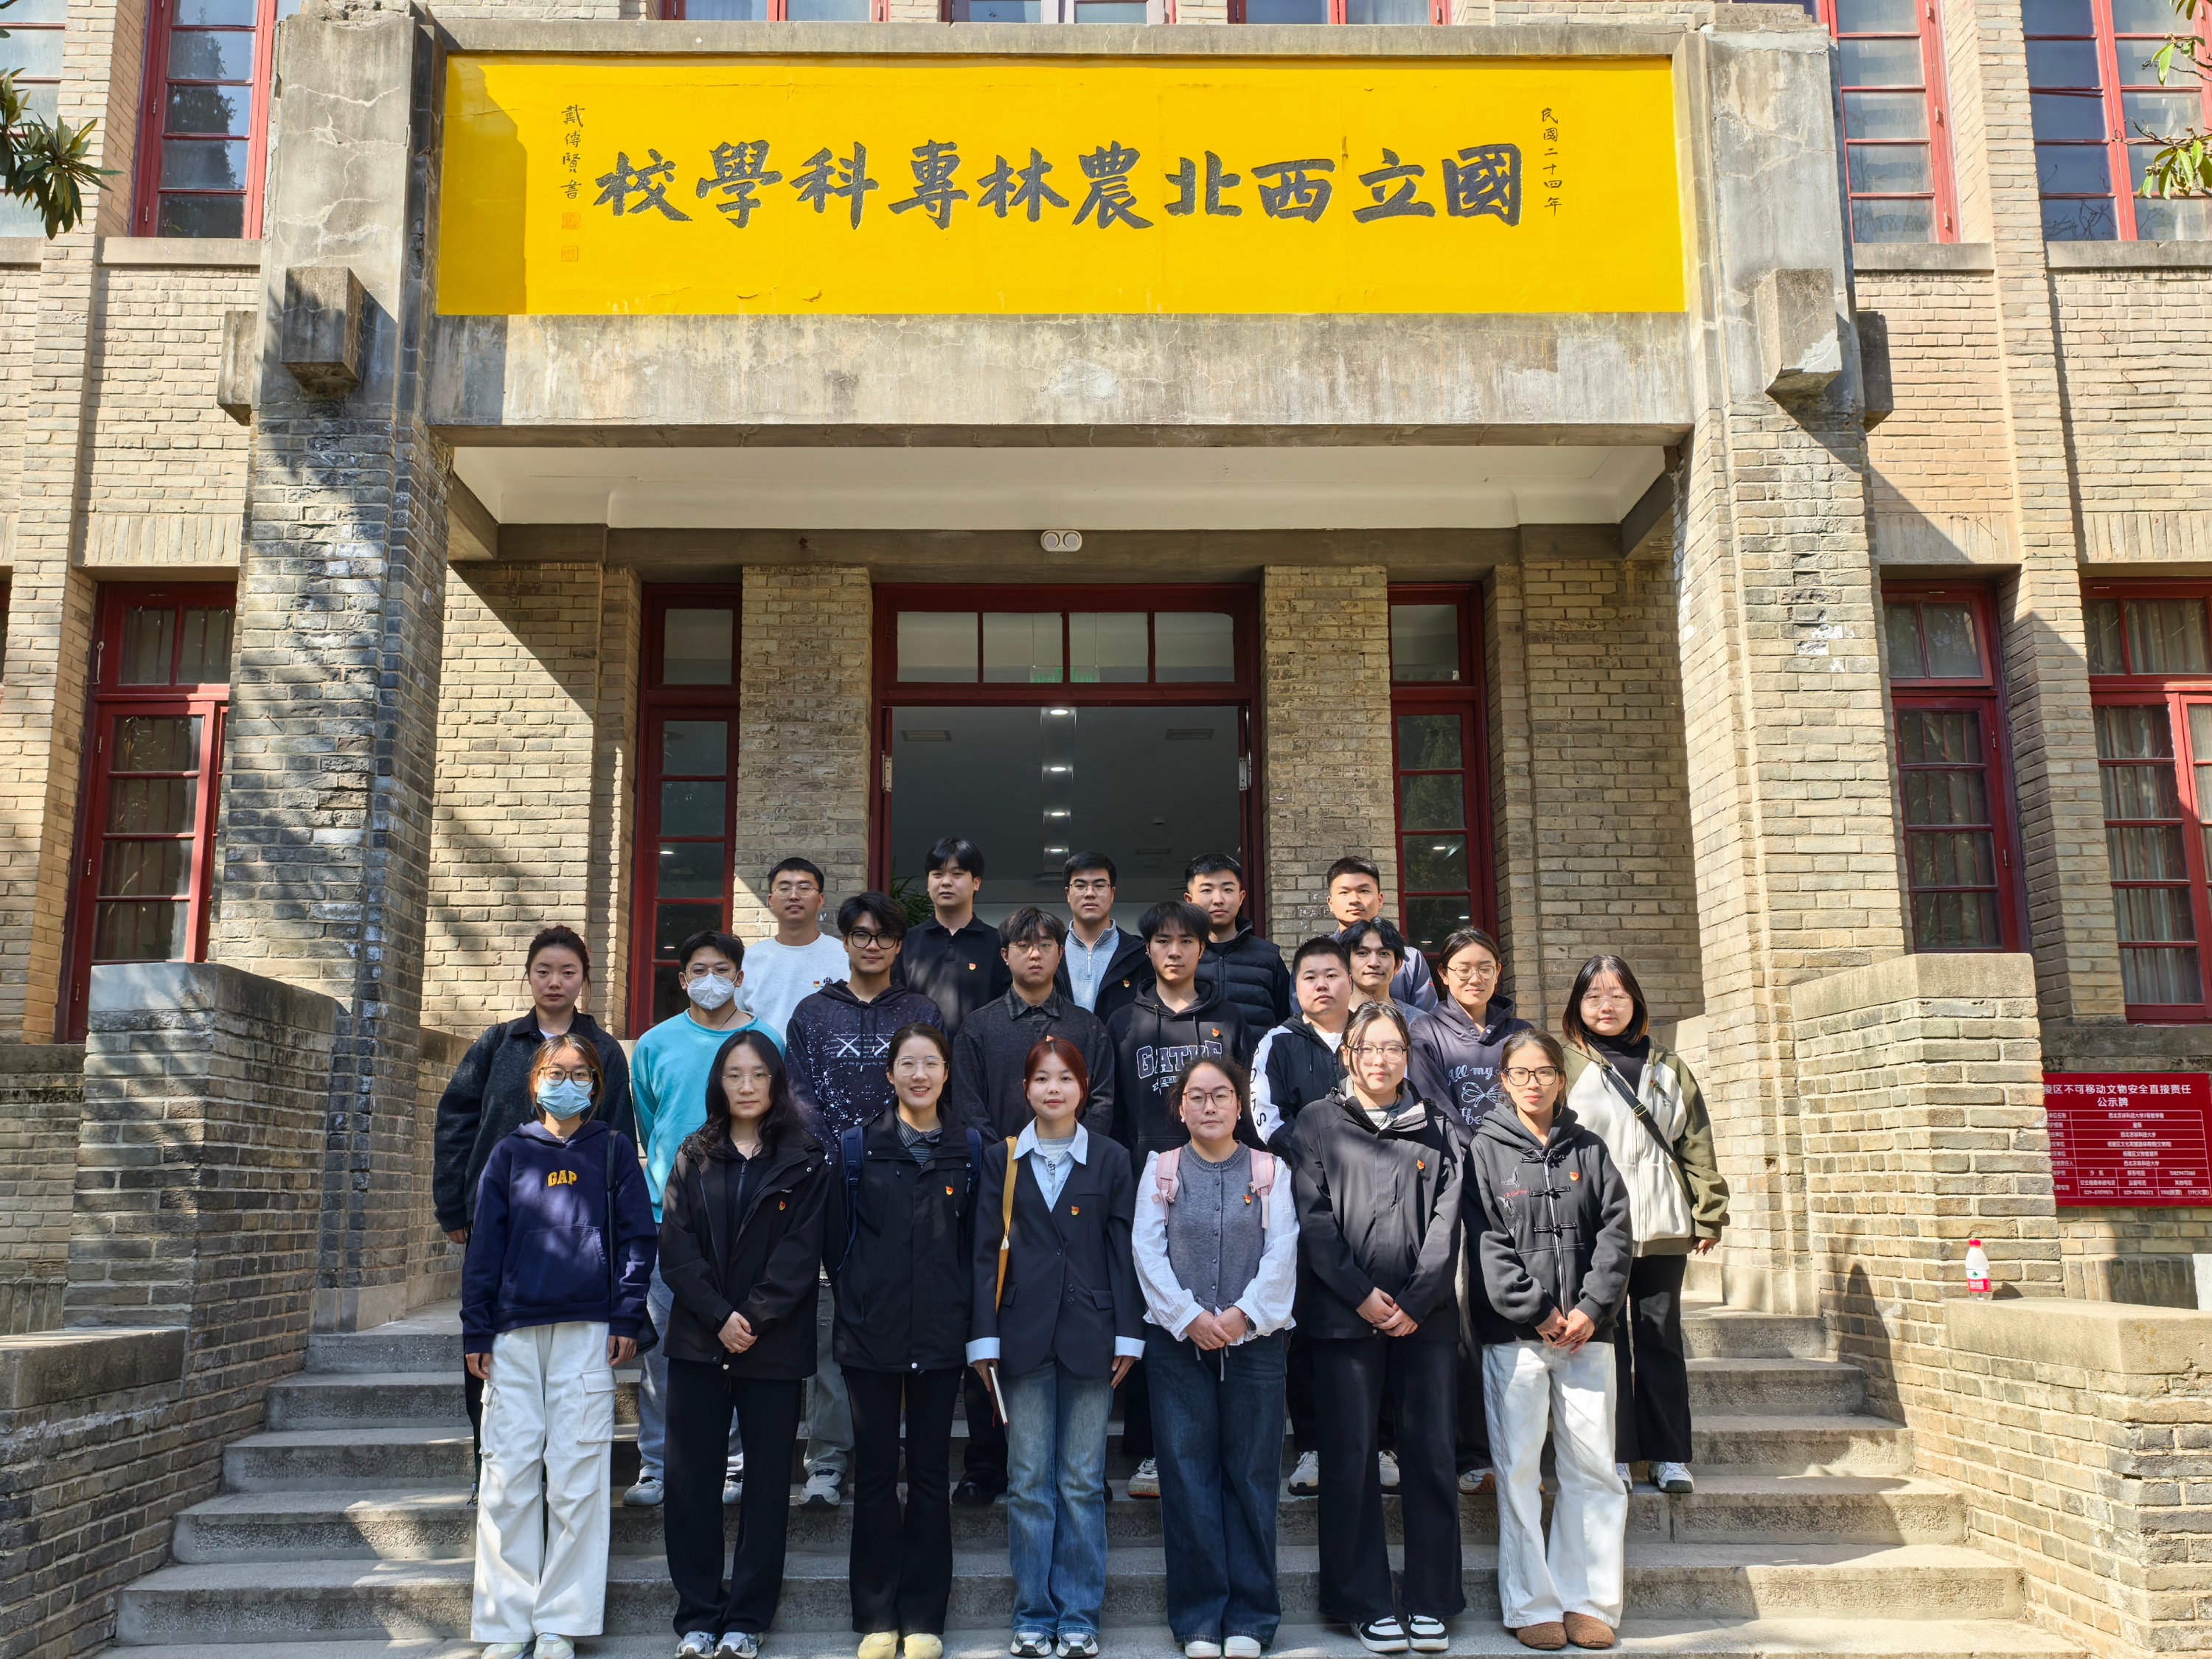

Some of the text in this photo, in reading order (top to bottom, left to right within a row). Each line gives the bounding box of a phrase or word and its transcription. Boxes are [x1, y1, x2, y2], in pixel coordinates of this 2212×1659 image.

[1541, 107, 1562, 217] 民國二十四年
[1470, 1066, 1493, 1080] my
[2097, 1096, 2129, 1107] 公示牌
[548, 1169, 577, 1187] GAP
